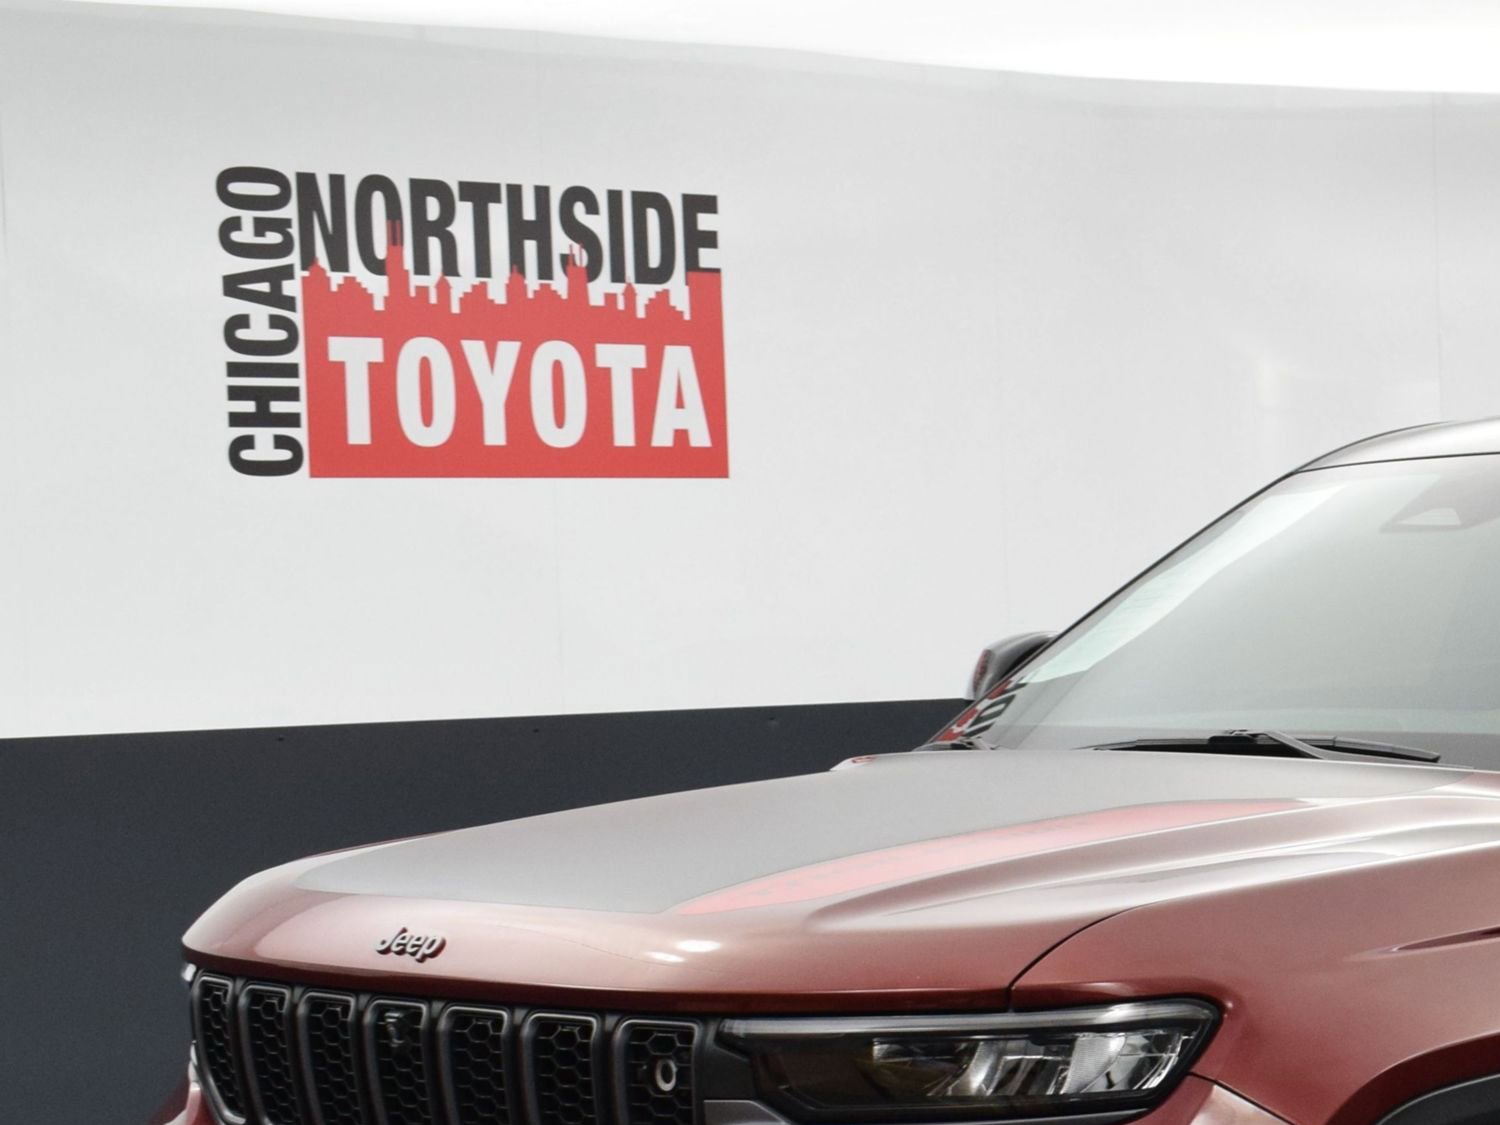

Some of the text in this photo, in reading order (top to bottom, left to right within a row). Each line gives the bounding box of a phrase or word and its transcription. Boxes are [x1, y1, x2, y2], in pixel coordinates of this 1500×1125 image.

[295, 171, 720, 286] NORTHSIDE
[216, 166, 303, 477] CHICAGO
[328, 336, 713, 448] TOYOTA
[375, 926, 447, 964] Jeep
